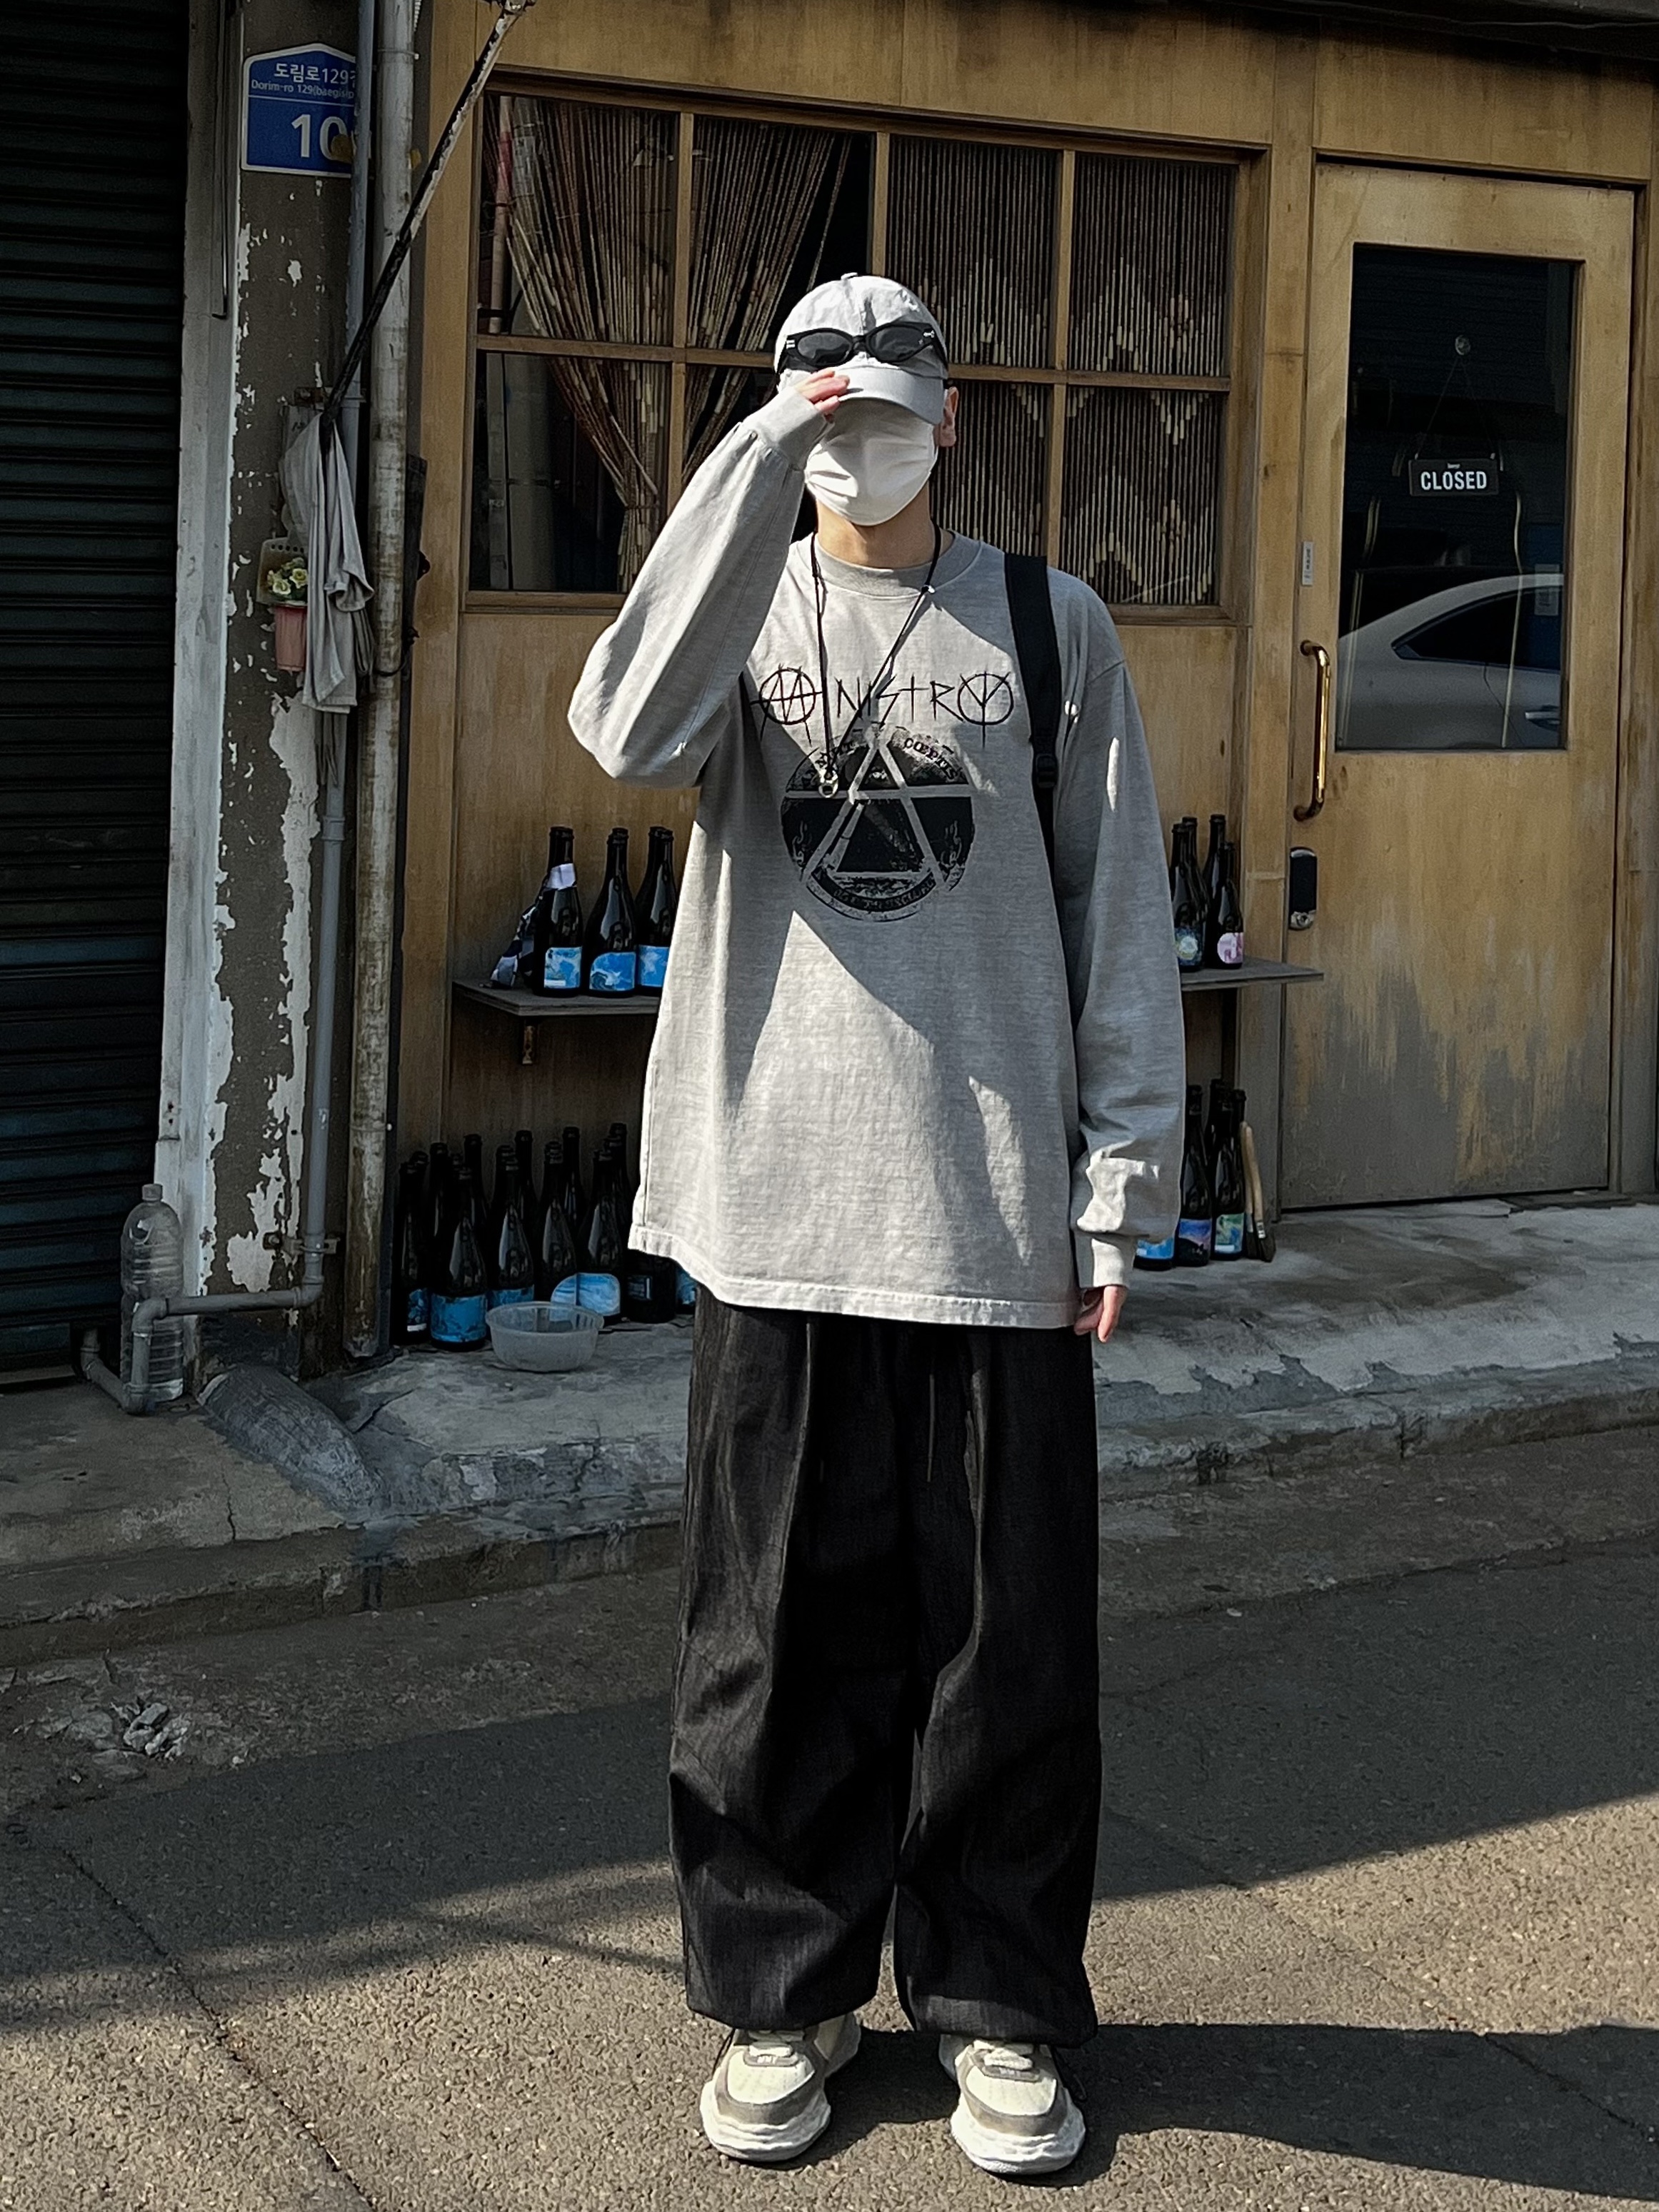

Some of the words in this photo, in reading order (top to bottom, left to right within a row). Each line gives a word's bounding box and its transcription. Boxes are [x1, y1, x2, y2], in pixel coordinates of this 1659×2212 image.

[251, 79, 294, 92] Dorim-ro
[291, 114, 349, 161] 10
[1420, 471, 1487, 490] CLOSED
